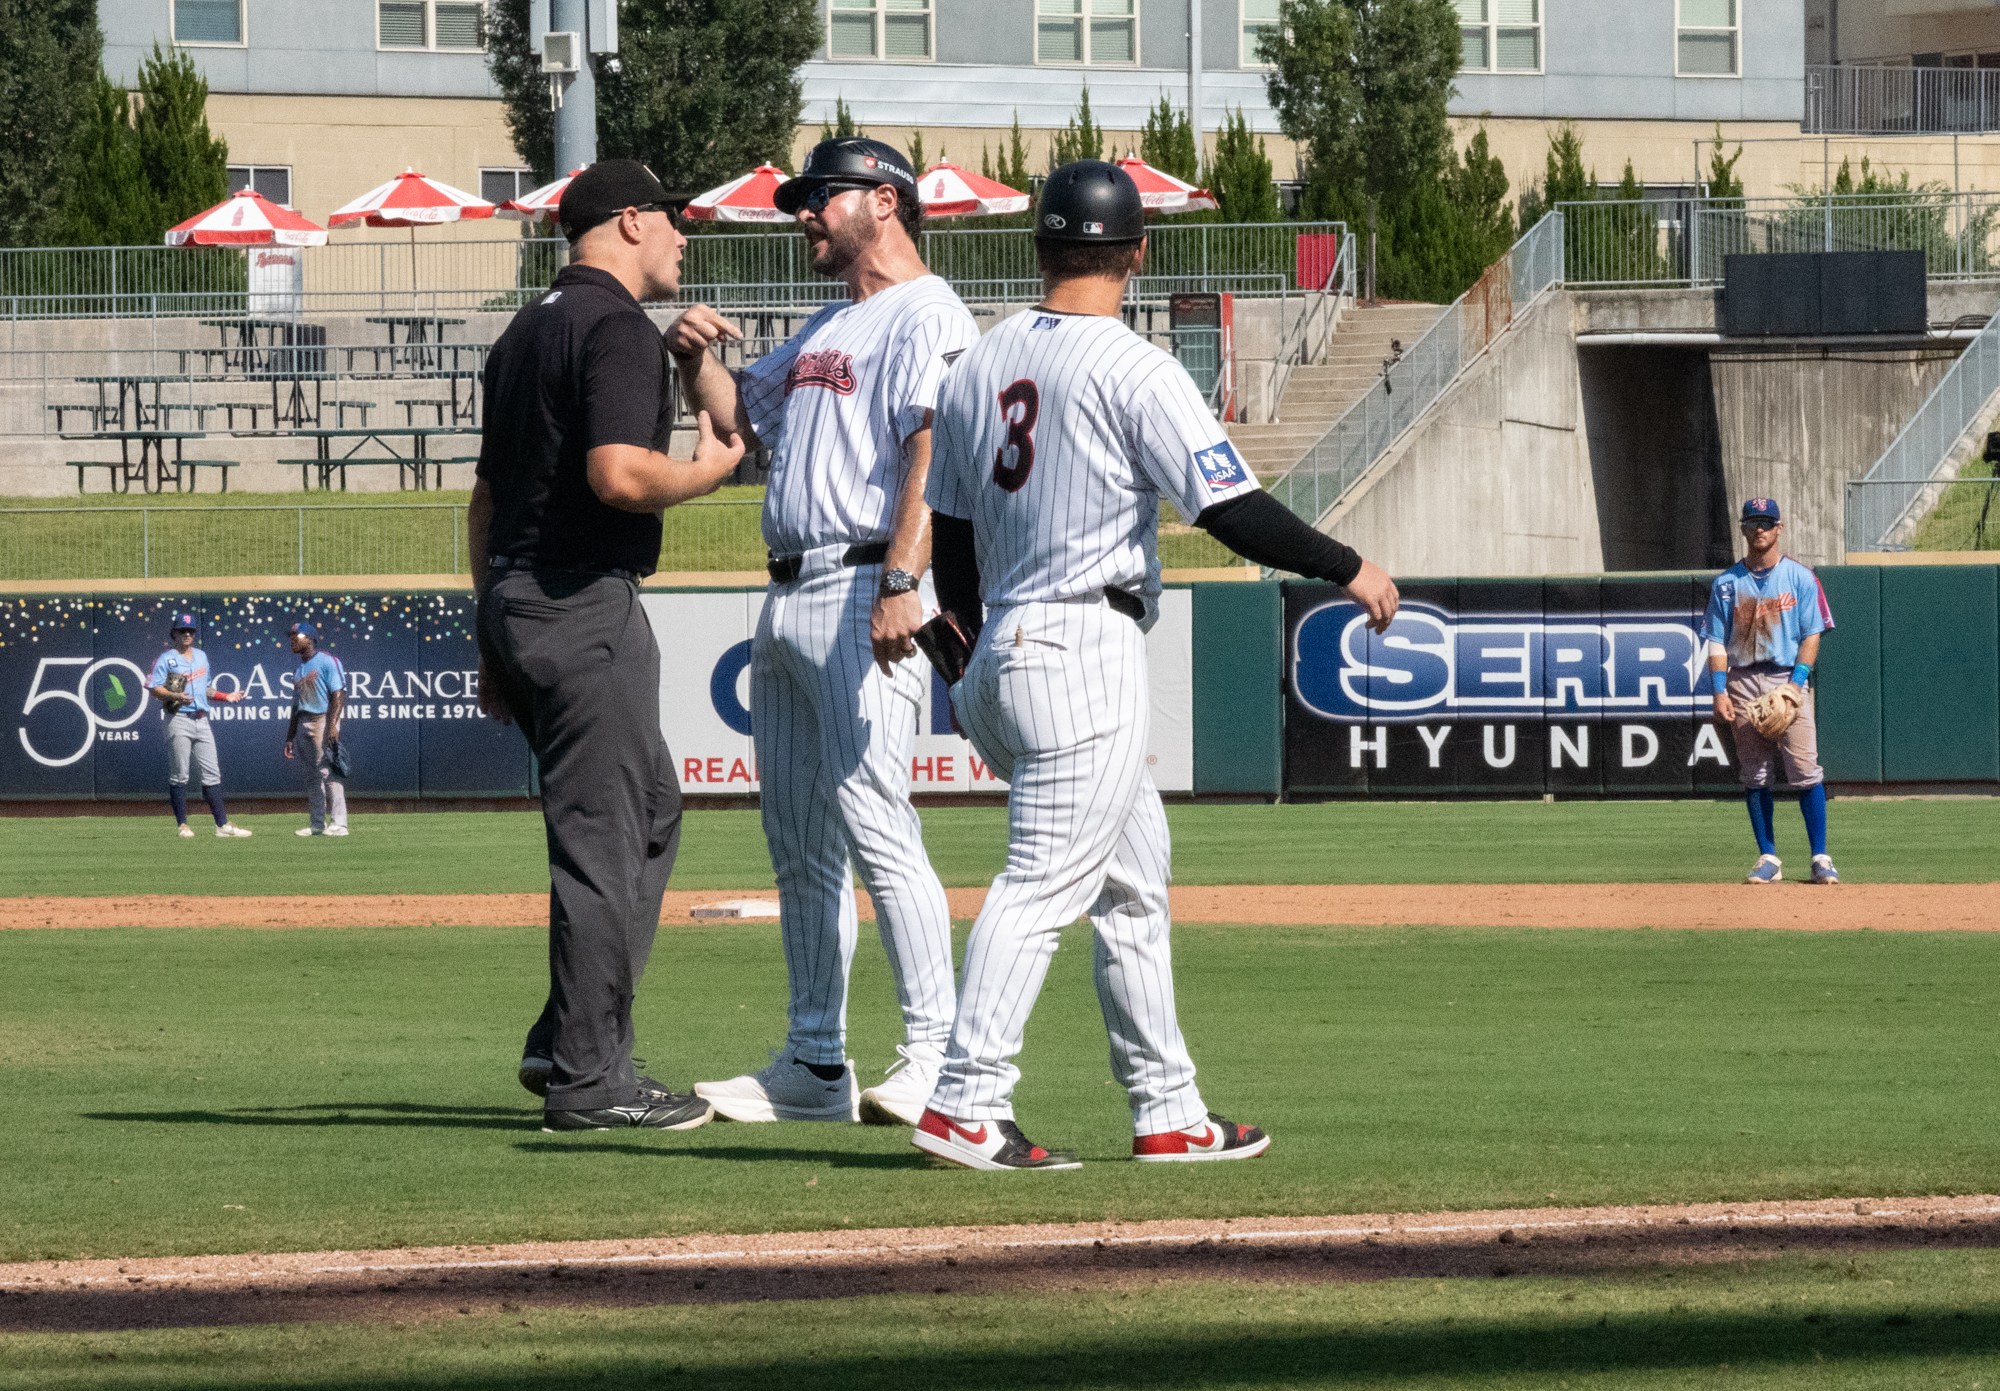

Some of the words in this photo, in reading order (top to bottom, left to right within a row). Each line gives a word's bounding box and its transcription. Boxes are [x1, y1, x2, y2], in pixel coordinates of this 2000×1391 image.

[993, 378, 1039, 493] 3
[1210, 467, 1237, 483] USAA
[18, 657, 150, 767] 50
[378, 704, 437, 719] SINCE
[99, 731, 139, 741] YEARS
[1349, 724, 1730, 769] HYUNDA
